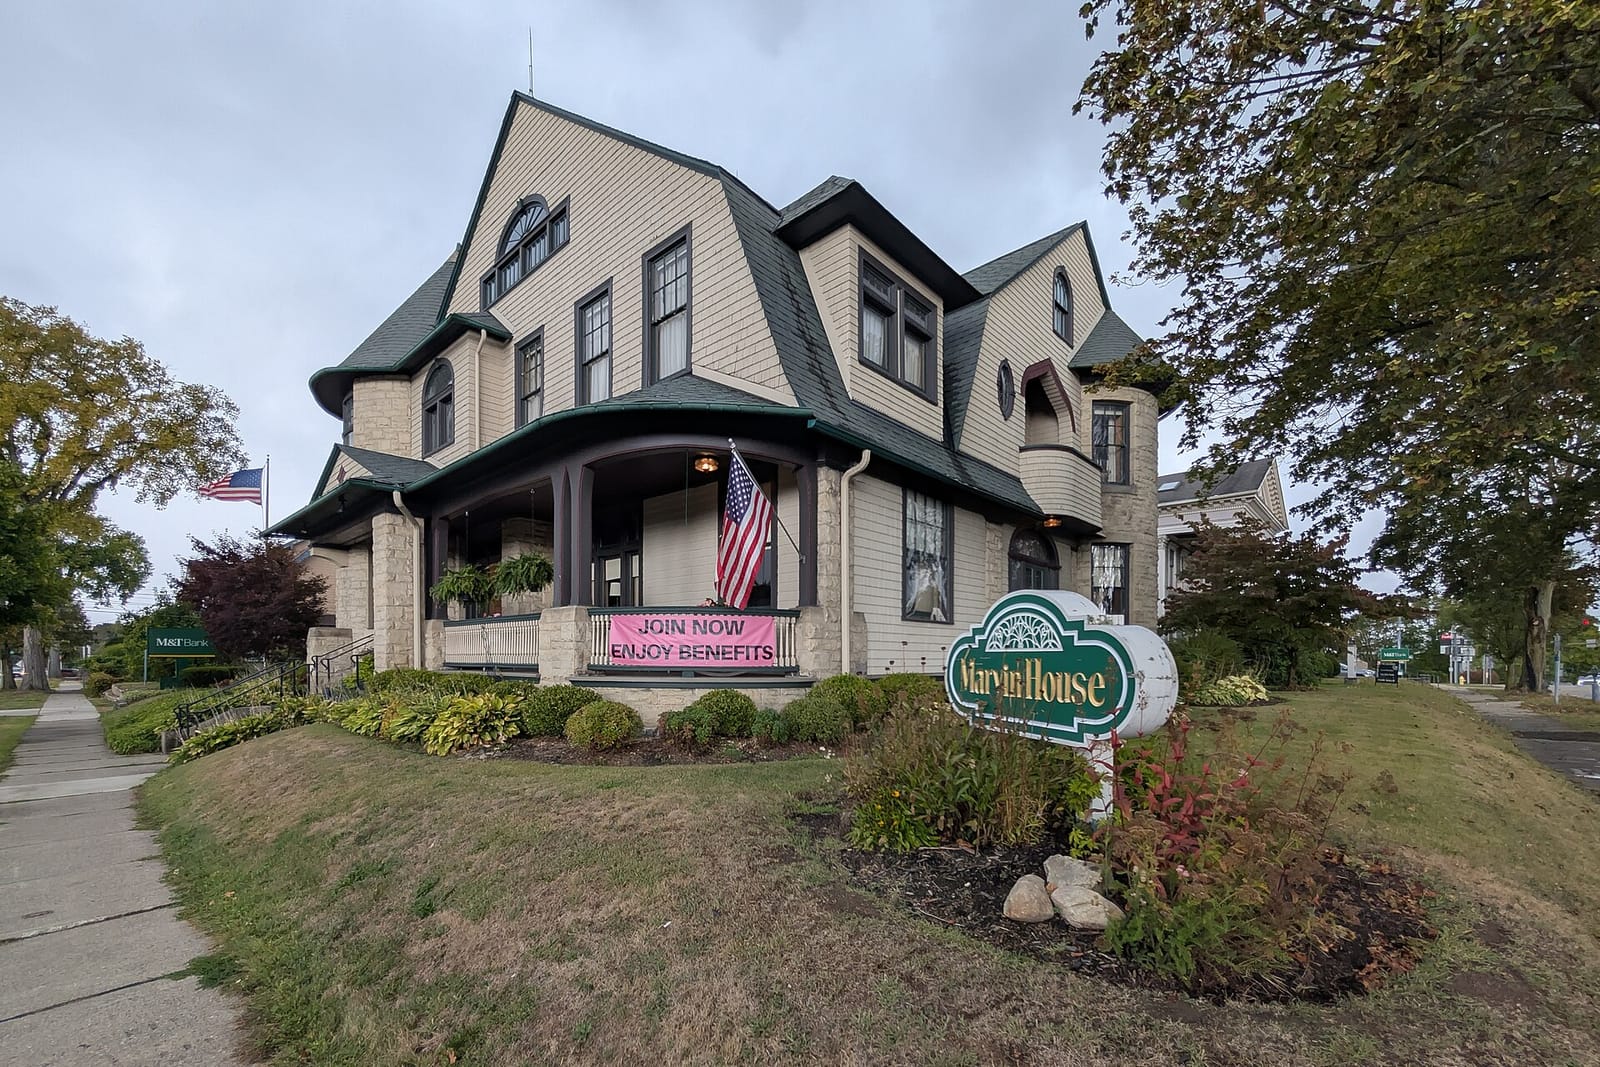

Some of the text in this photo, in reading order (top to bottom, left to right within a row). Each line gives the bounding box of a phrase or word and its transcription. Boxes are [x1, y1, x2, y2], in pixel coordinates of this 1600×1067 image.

[638, 619, 745, 636] JOIN NOW
[156, 638, 208, 647] M&T Bank
[611, 644, 774, 661] ENJOY BENEFITS
[960, 657, 1105, 707] Marvin House
